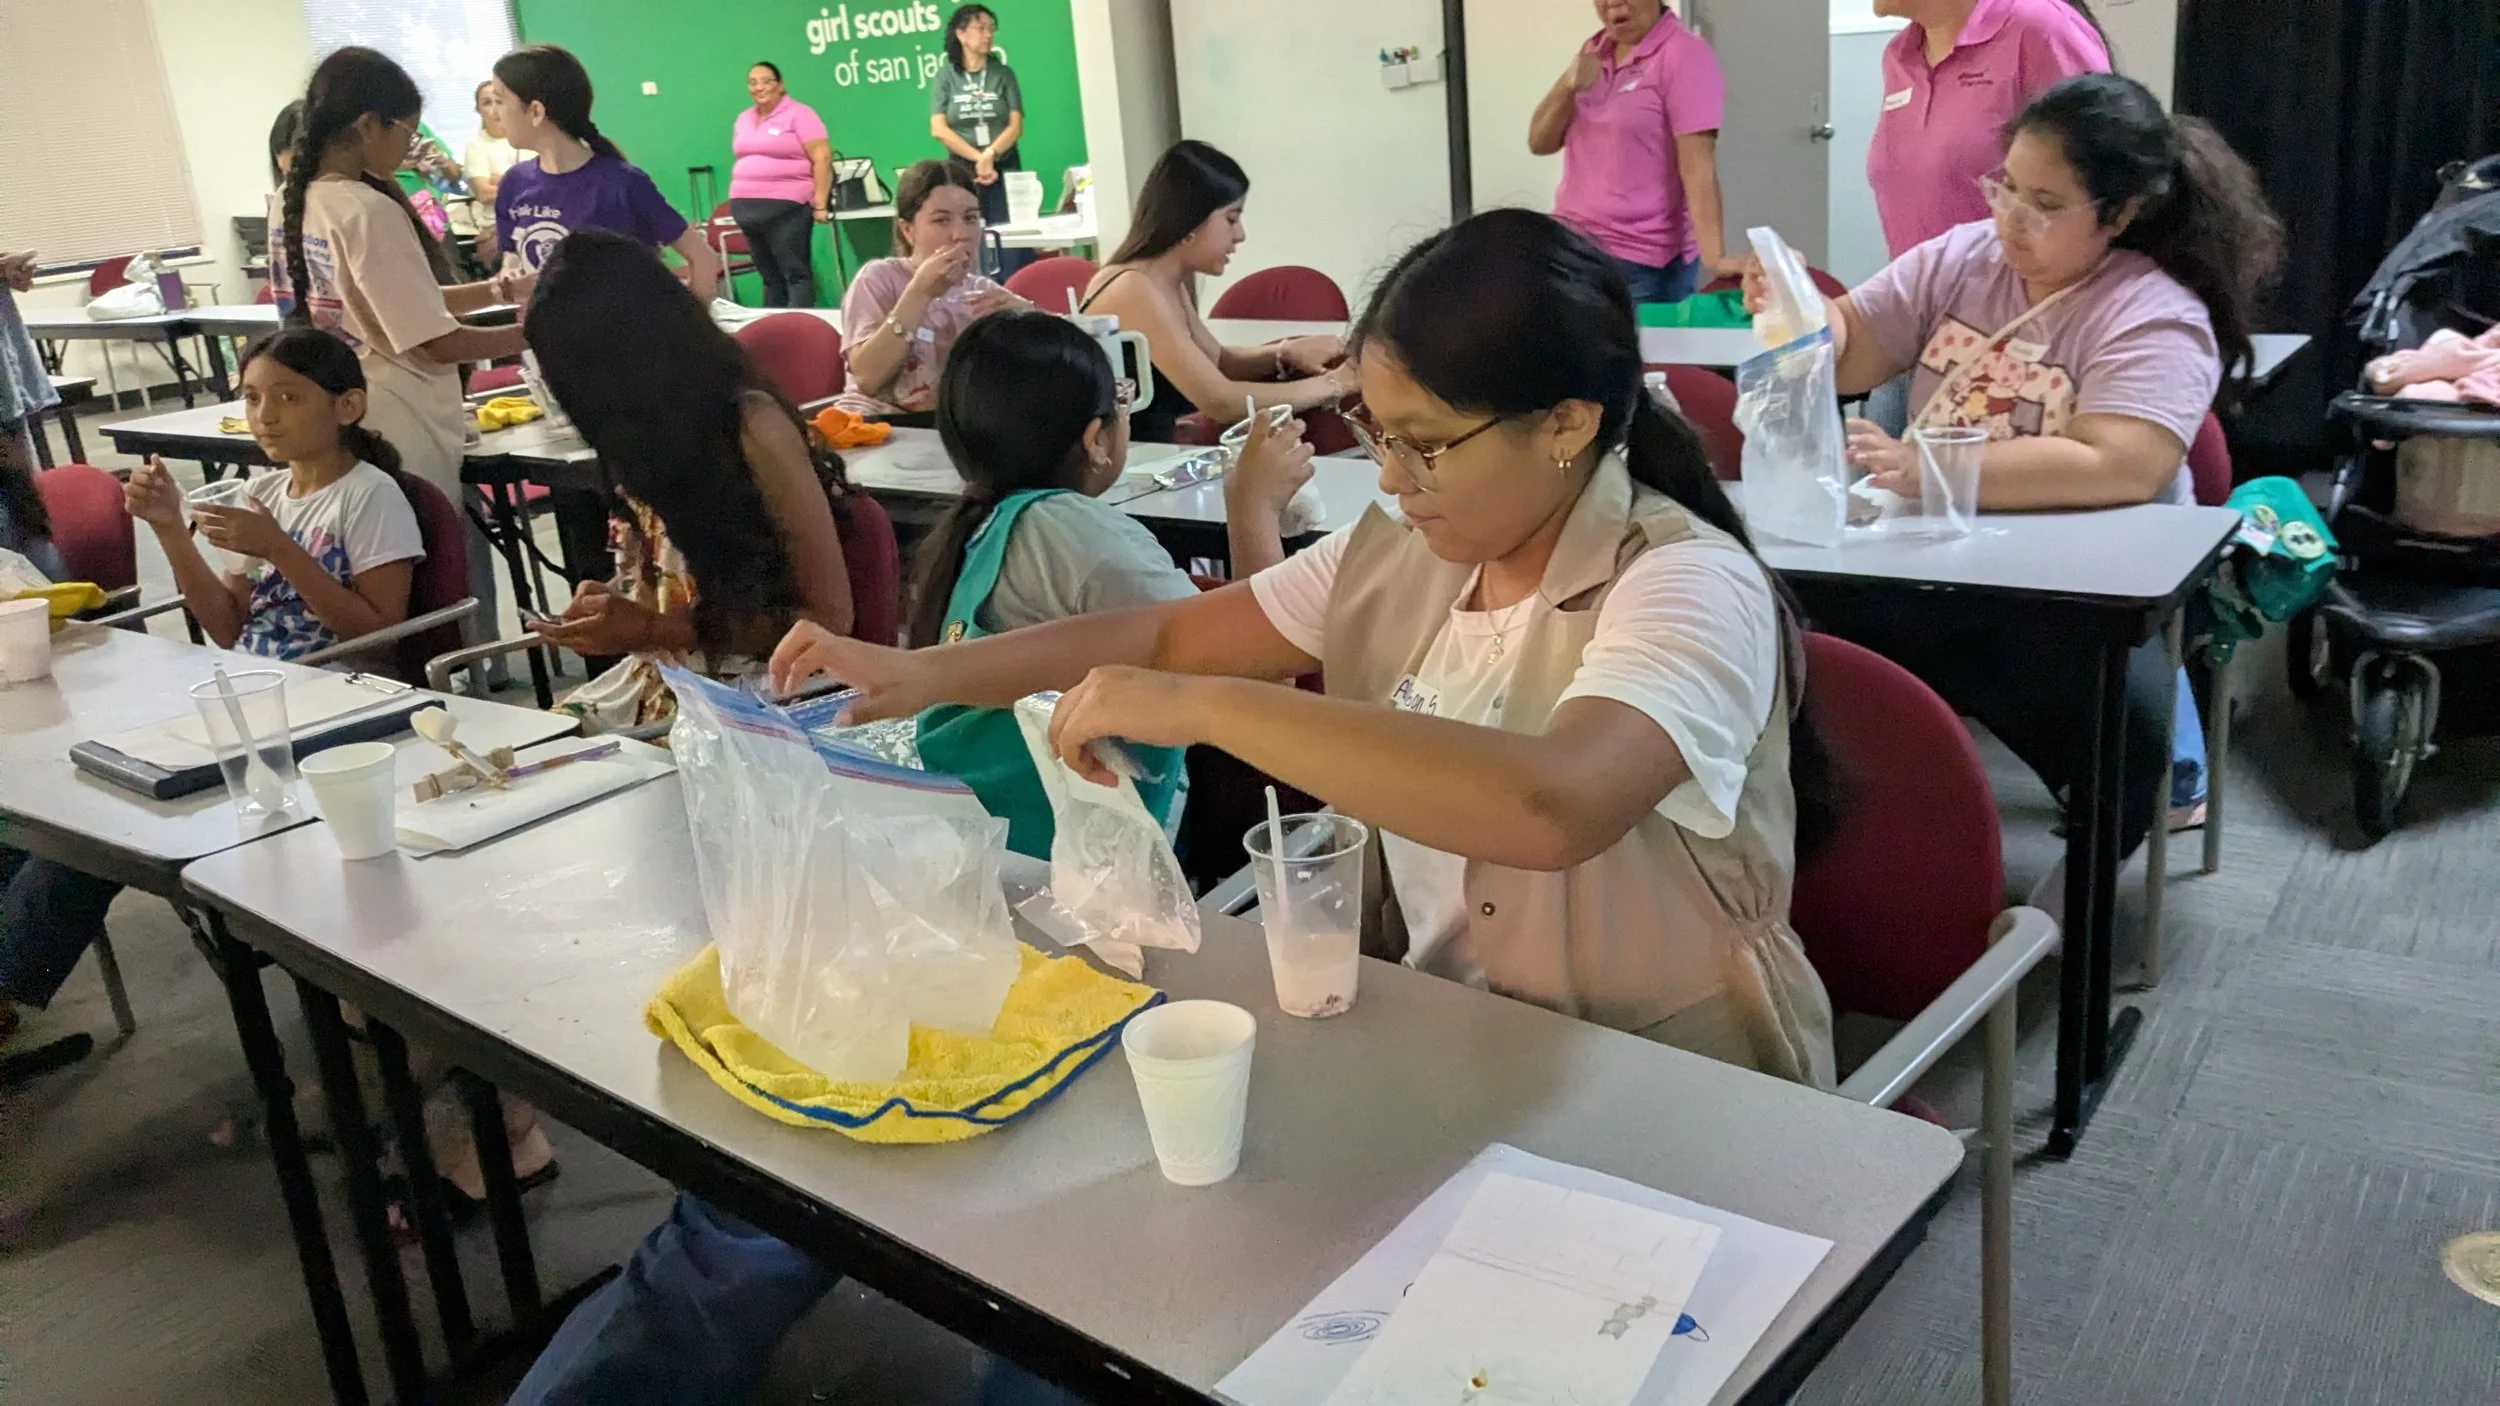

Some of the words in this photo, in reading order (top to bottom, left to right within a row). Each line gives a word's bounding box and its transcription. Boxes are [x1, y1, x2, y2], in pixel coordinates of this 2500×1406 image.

[806, 3, 851, 55] girl
[854, 0, 942, 39] scouts
[835, 48, 860, 87] of
[866, 55, 911, 84] san
